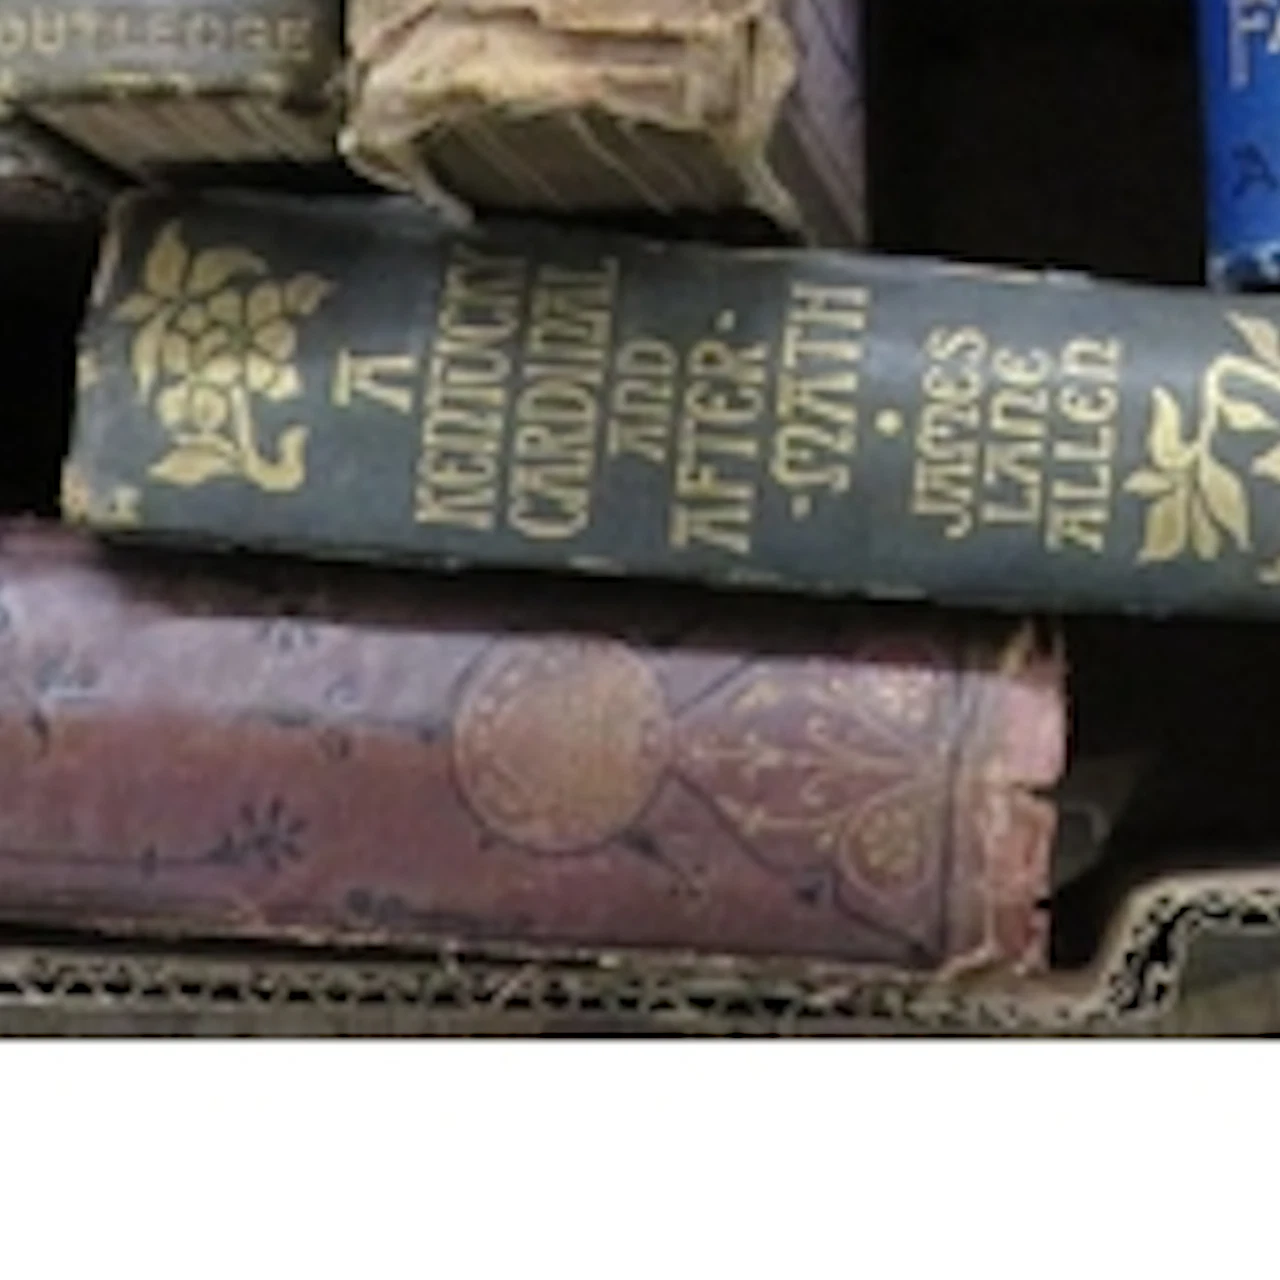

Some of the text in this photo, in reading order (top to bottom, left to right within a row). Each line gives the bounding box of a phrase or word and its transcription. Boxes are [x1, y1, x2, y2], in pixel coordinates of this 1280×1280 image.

[332, 346, 418, 414] A
[413, 248, 520, 532] KENTUCKY
[508, 254, 619, 541] CARDINAL
[608, 337, 681, 464] AND
[910, 324, 988, 541] JAMES
[982, 345, 1052, 530] LANE
[1045, 334, 1122, 555] ALLEN
